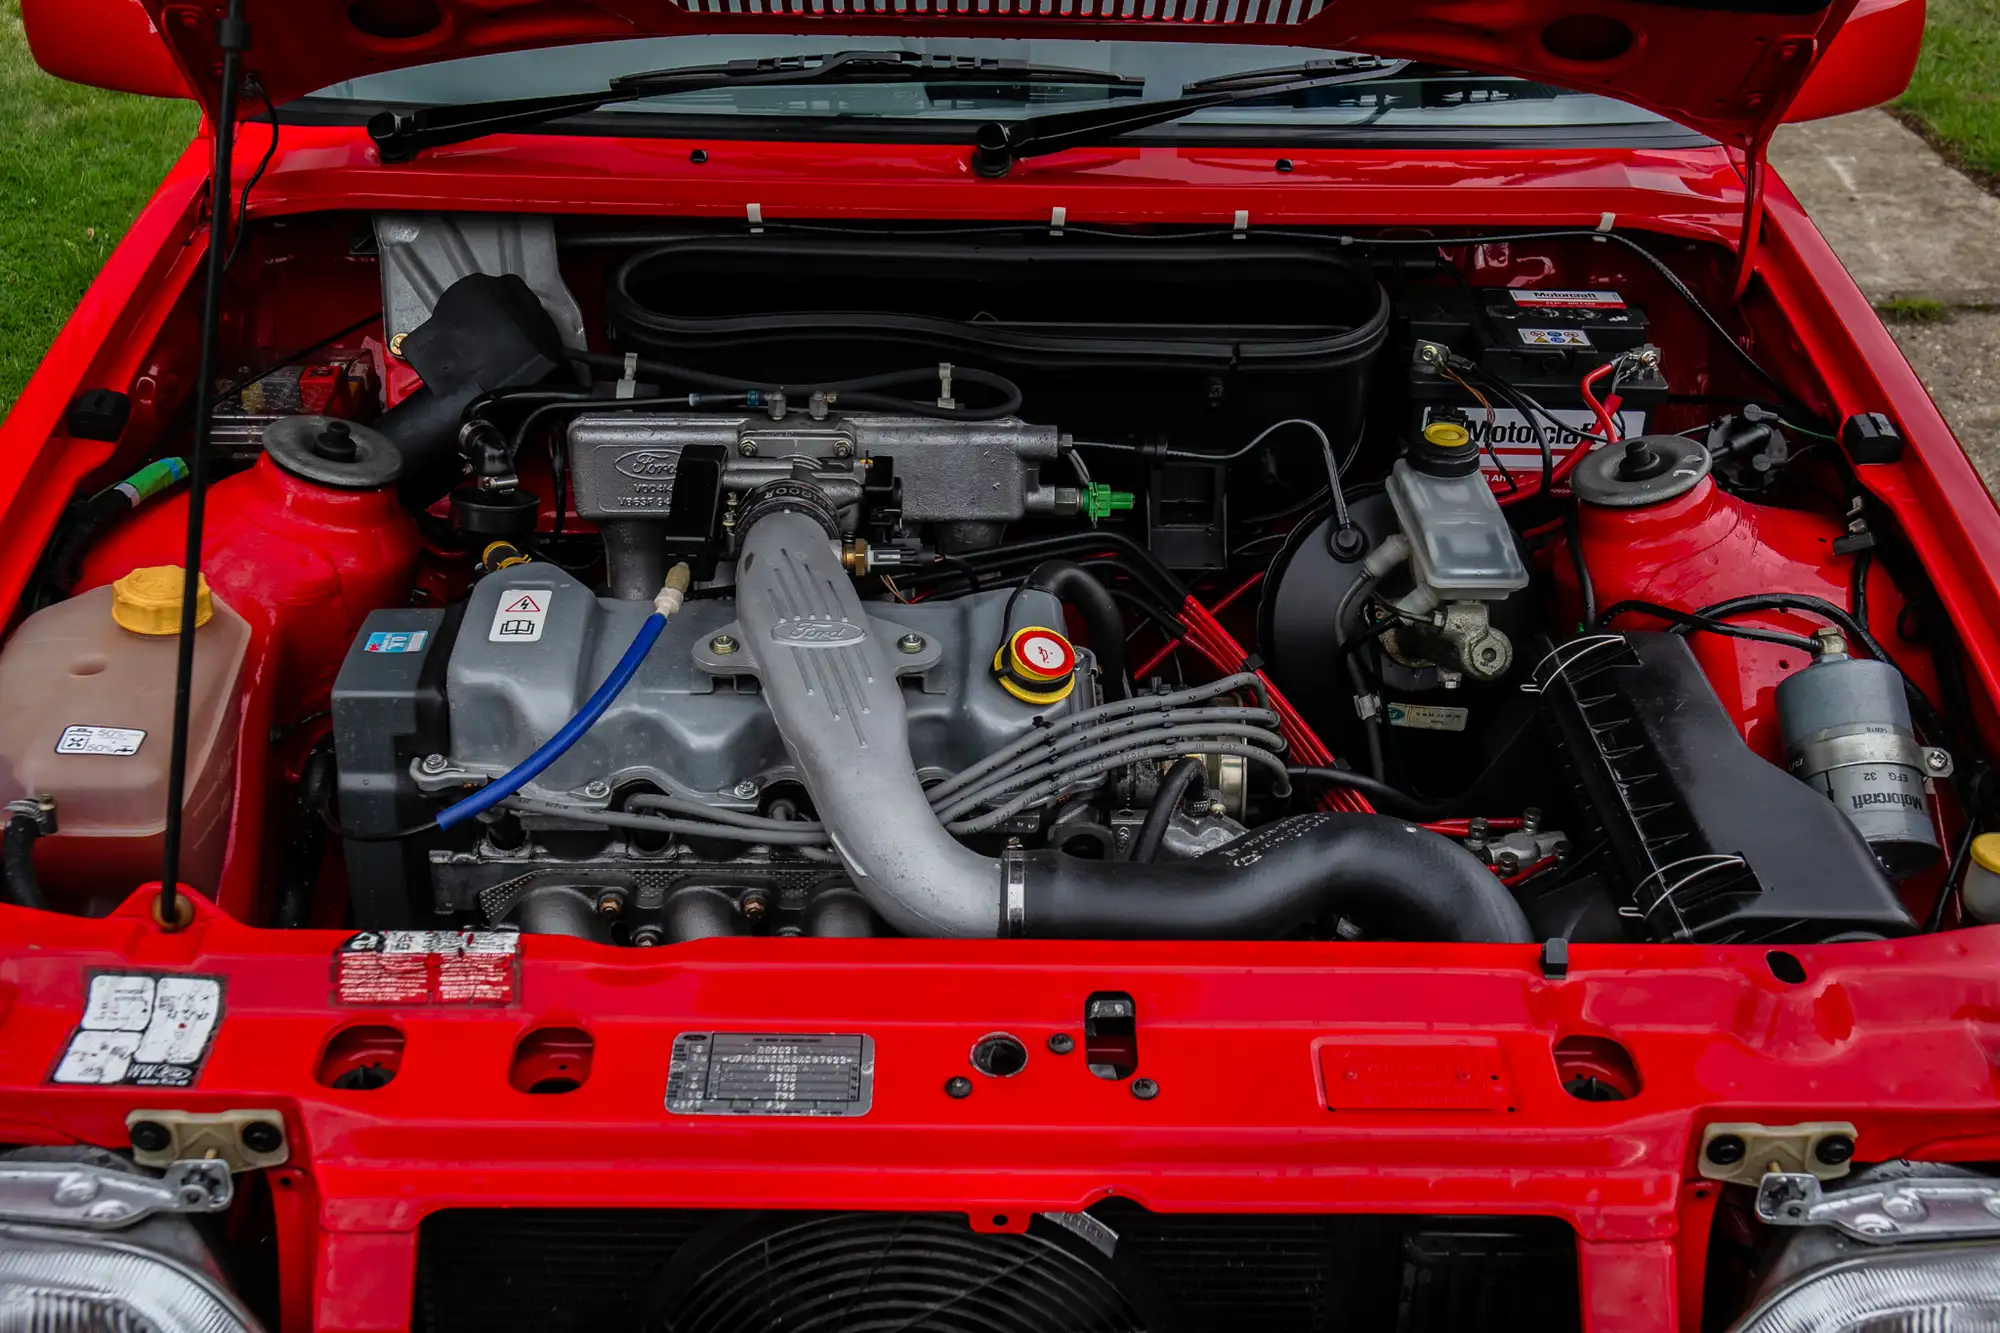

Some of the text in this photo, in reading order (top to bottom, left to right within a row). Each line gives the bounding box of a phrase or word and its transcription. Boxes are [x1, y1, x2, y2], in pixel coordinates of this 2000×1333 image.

[1533, 291, 1597, 299] Motorcraft
[1467, 419, 1597, 445] Motorcraf
[790, 622, 847, 640] Ford
[1863, 771, 1909, 783] EFG 32
[1851, 792, 1923, 812] Motorcraft
